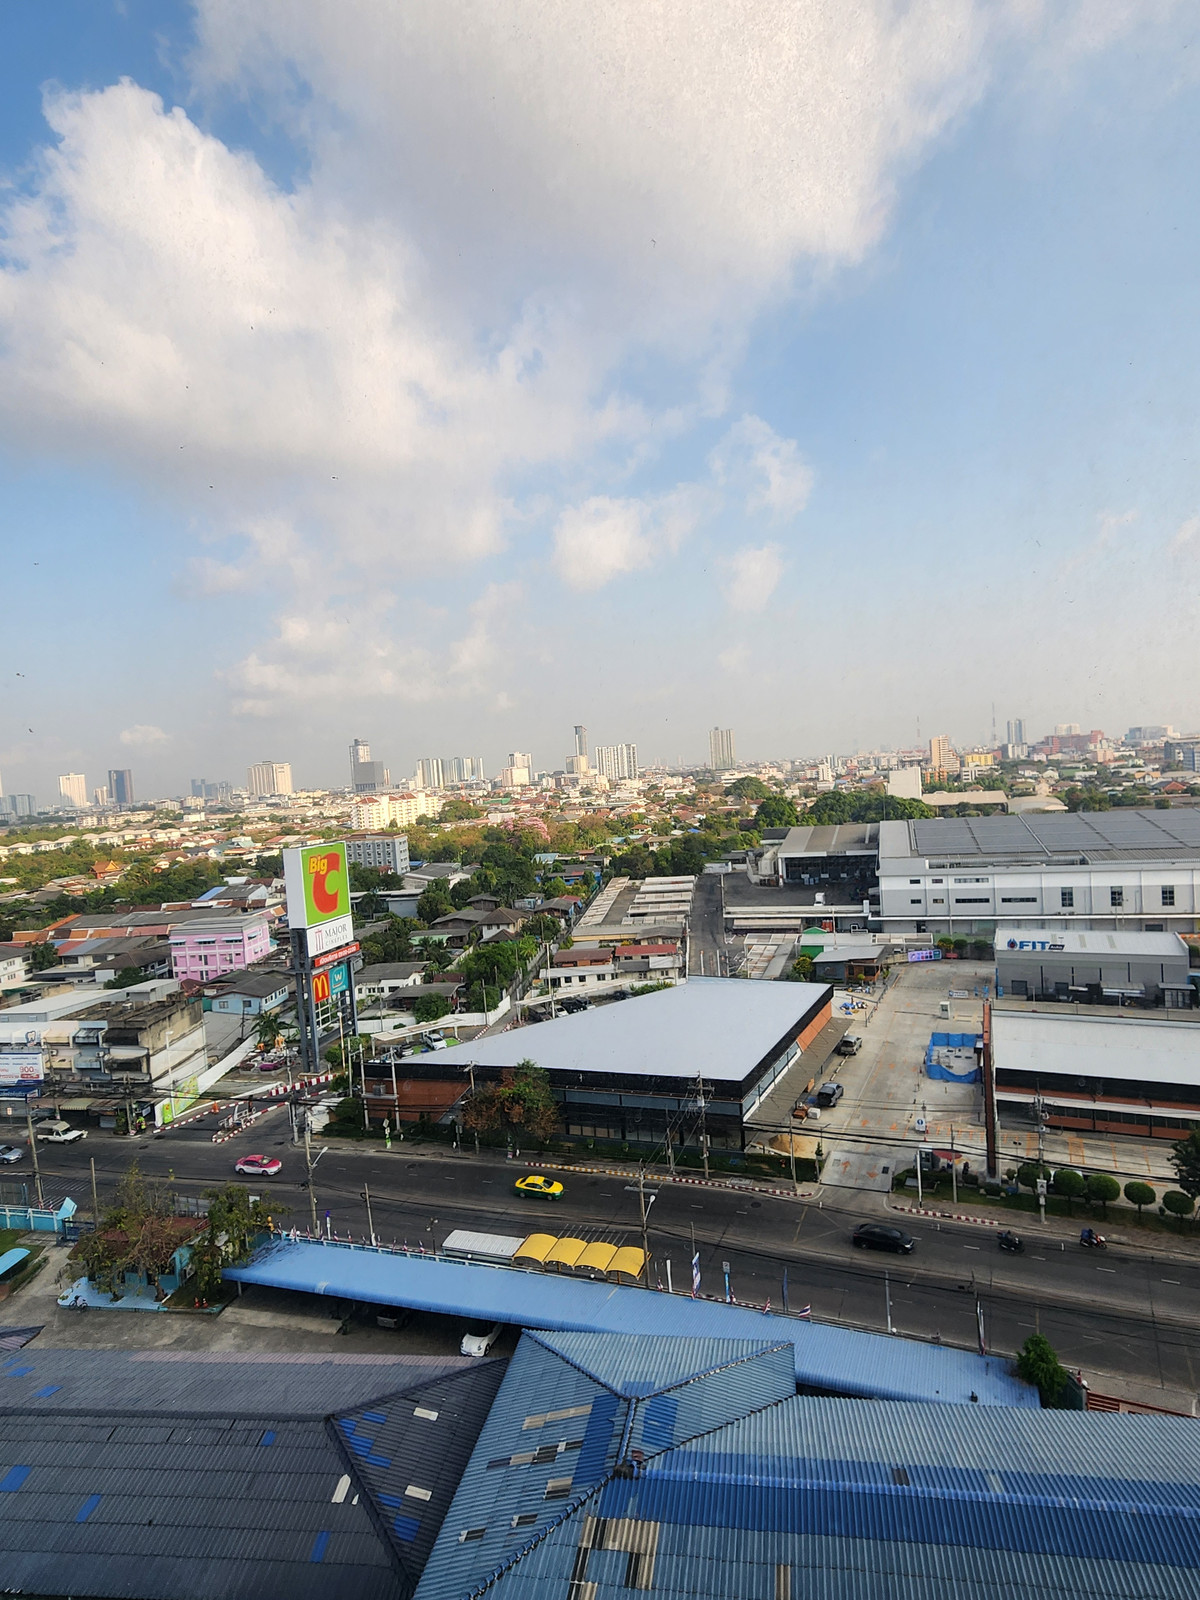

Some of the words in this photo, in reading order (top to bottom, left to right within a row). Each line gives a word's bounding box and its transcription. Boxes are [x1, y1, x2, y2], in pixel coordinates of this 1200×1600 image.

[309, 855, 327, 875] Big
[312, 852, 341, 914] C
[325, 924, 347, 937] MAJOR
[1019, 941, 1050, 950] FIT
